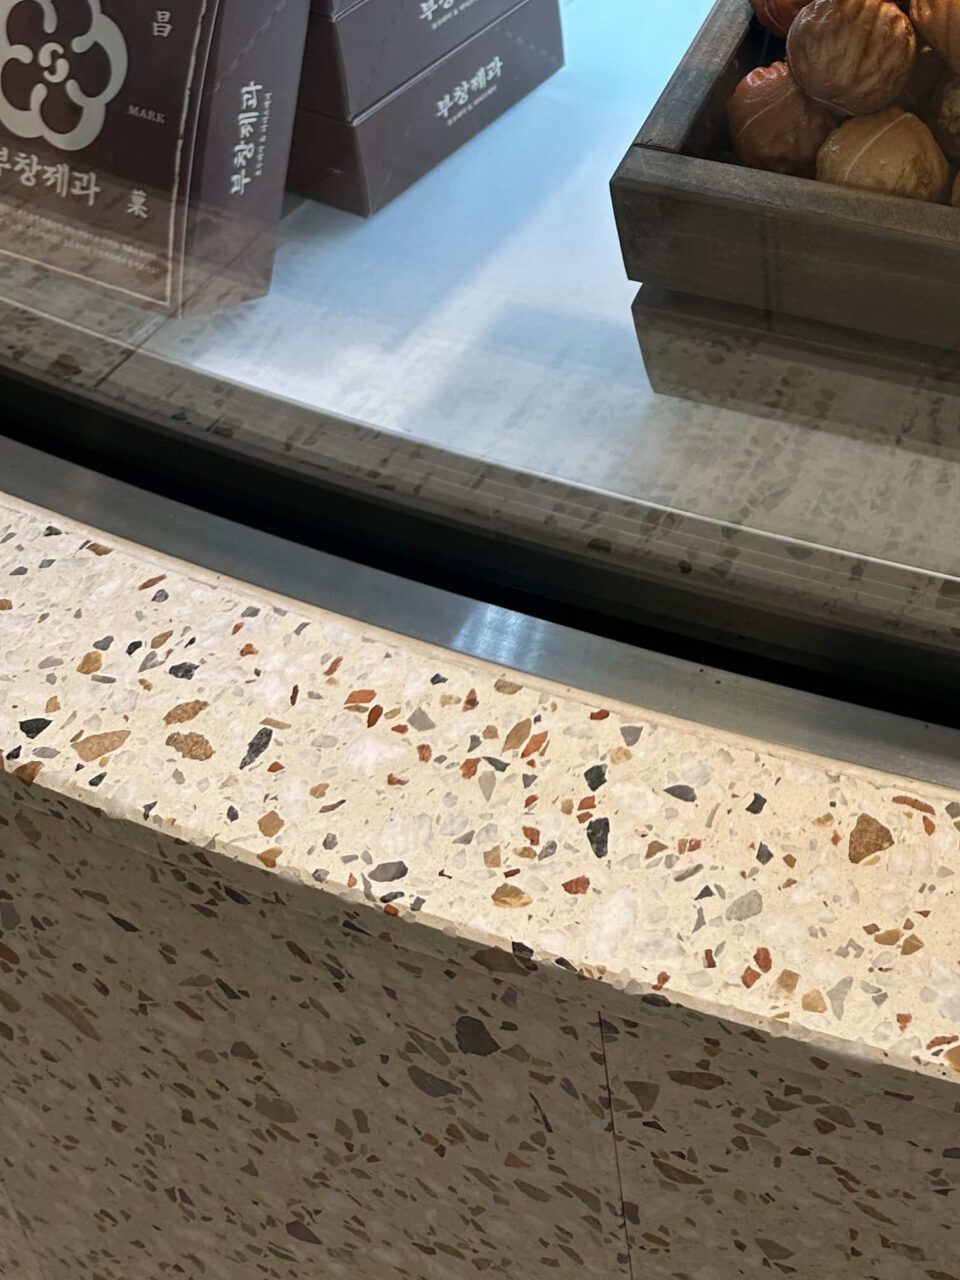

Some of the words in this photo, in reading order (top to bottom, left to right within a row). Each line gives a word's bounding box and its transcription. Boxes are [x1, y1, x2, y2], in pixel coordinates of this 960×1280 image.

[152, 10, 173, 38] 昌
[436, 56, 504, 118] 부창제과
[127, 104, 166, 124] MARK
[230, 80, 263, 196] 부창제과
